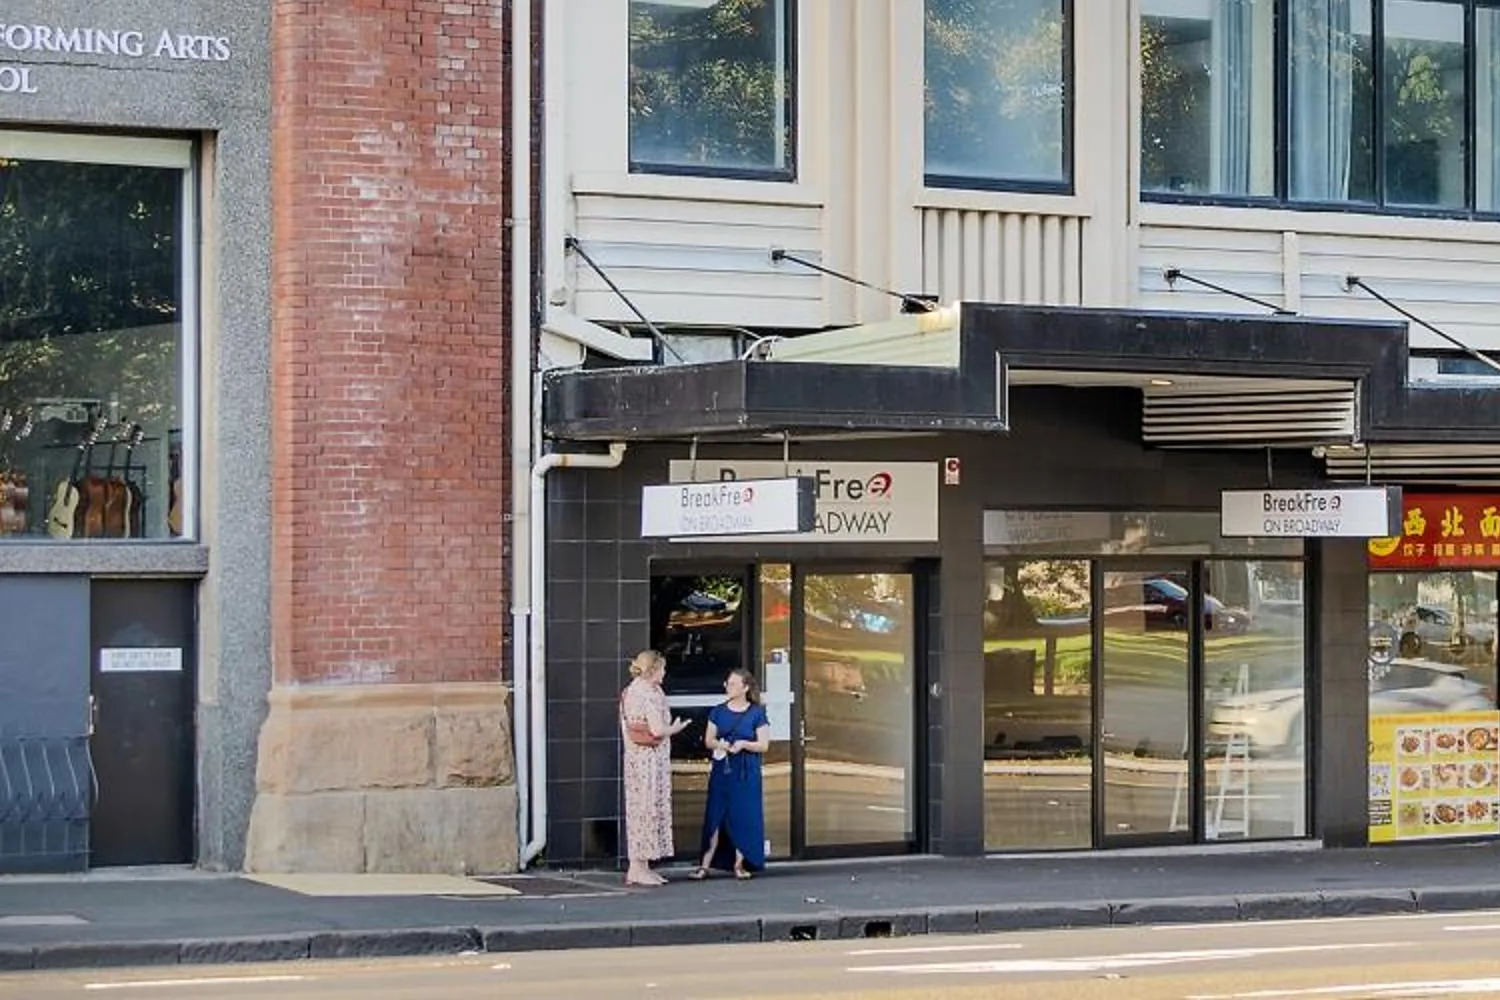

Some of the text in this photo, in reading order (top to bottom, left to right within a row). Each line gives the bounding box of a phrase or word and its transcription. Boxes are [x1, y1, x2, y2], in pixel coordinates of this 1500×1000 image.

[153, 29, 231, 61] ARTS
[1263, 518, 1341, 533] ON BROADWAY
